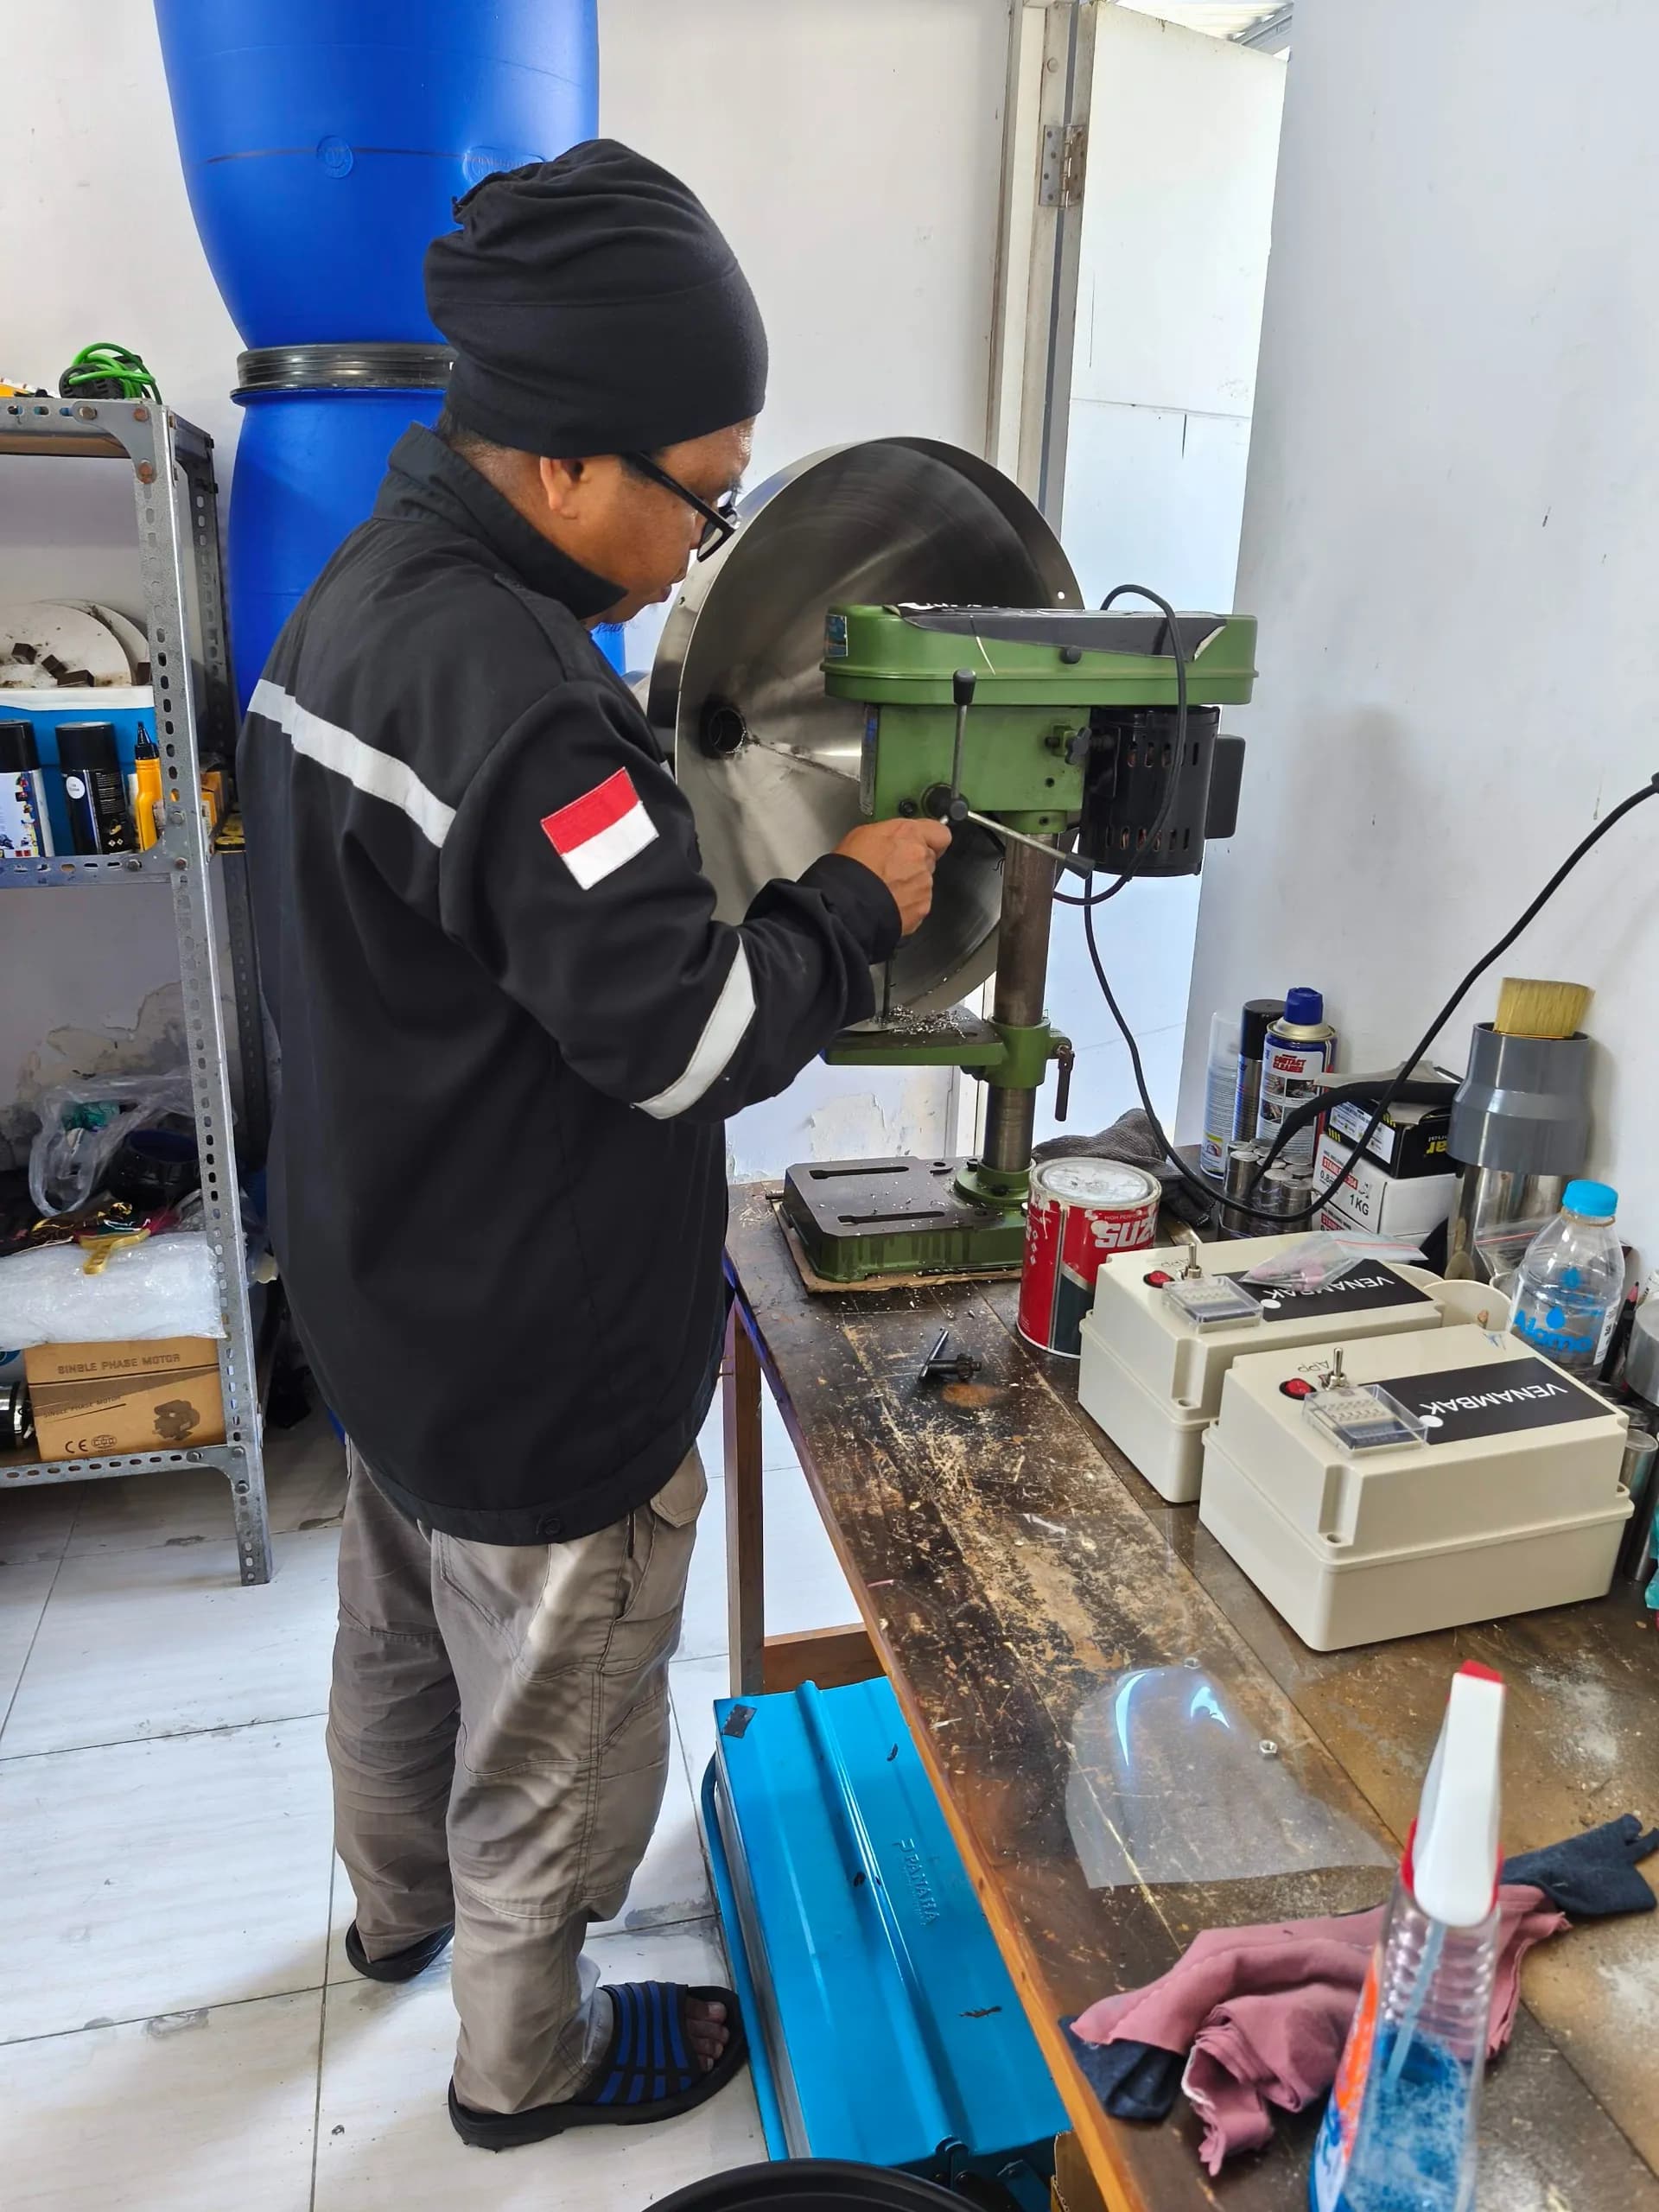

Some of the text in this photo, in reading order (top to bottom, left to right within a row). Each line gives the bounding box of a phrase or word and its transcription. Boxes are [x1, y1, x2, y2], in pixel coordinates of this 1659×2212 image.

[101, 1357, 138, 1371] PHASE
[142, 1353, 181, 1366] MOTOR
[1420, 1382, 1568, 1415] VENAMBAK
